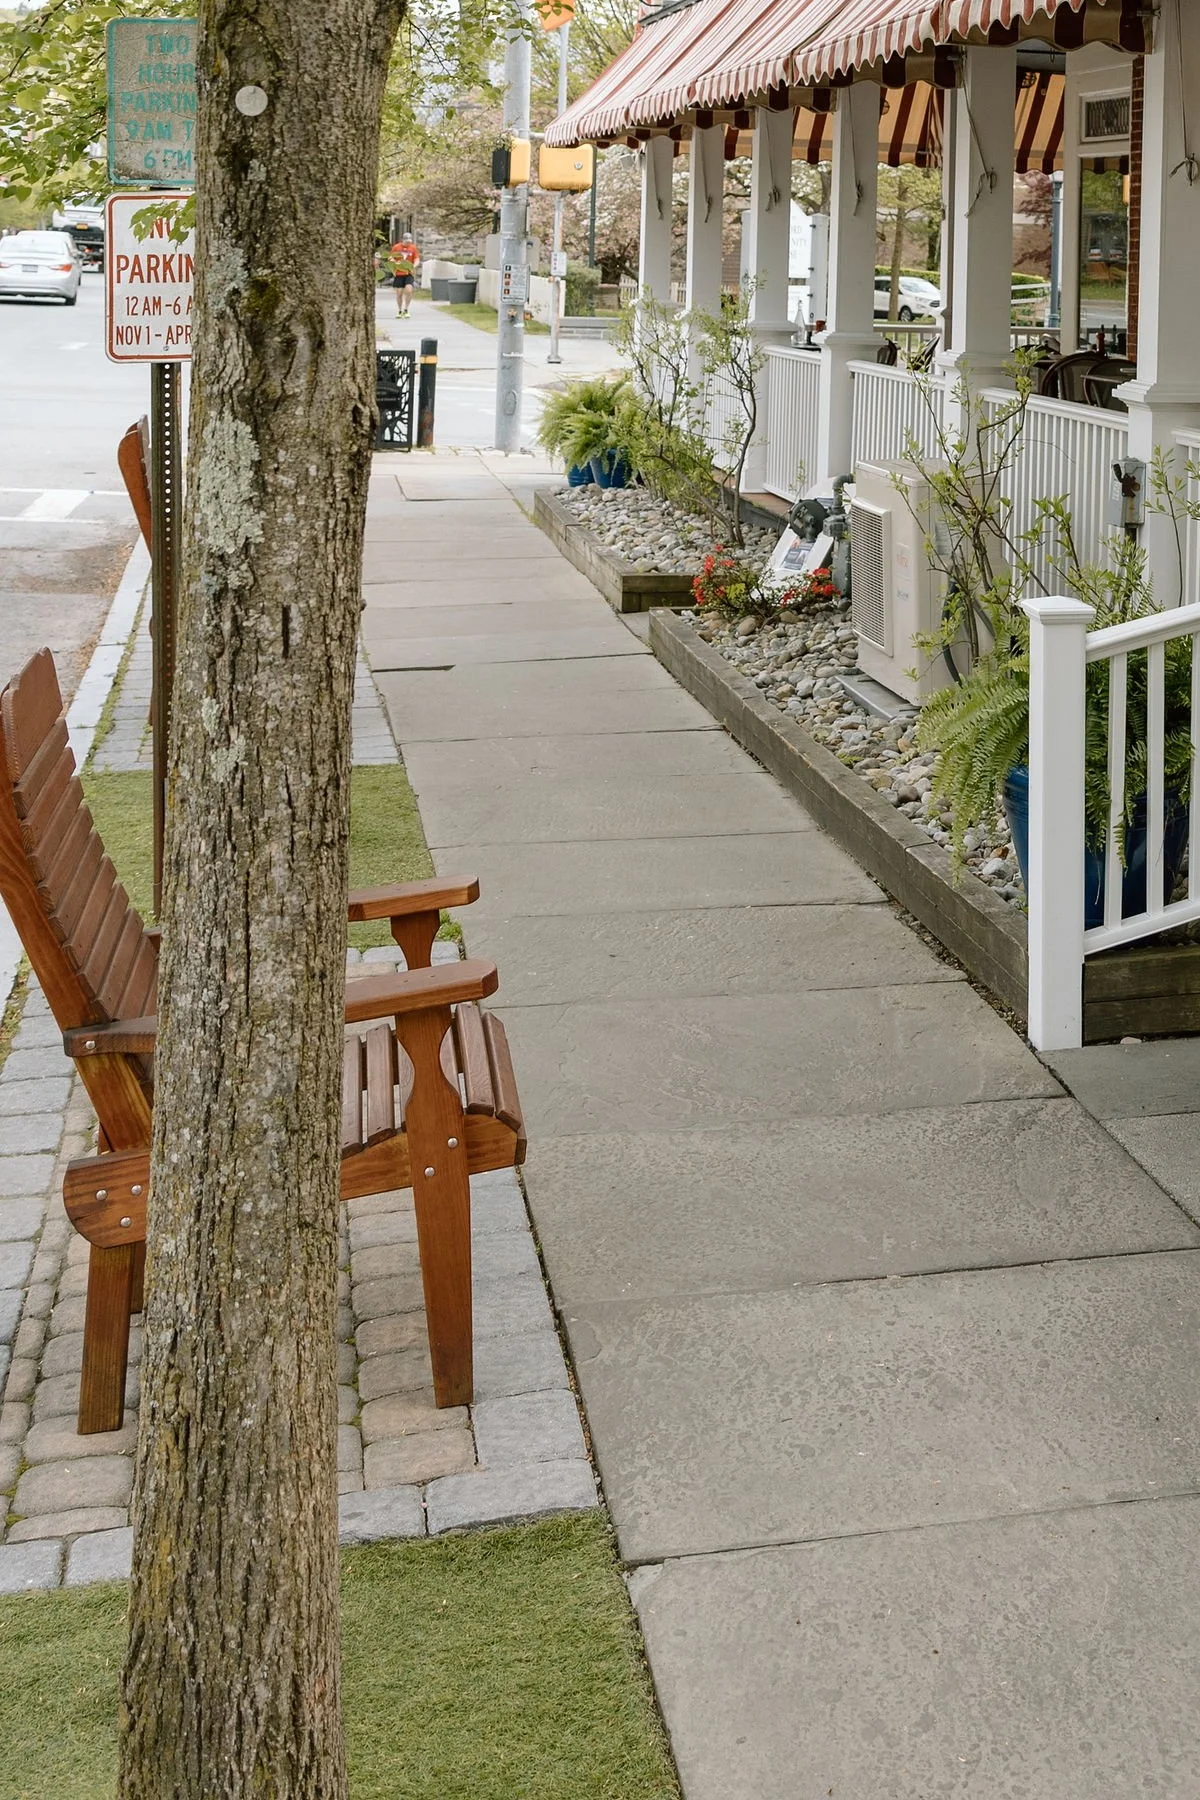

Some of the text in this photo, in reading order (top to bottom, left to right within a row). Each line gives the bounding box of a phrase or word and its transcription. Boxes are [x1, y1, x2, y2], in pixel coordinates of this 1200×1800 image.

[145, 33, 190, 56] TWO
[138, 63, 196, 85] HOUR
[121, 91, 197, 114] PARKIN
[183, 119, 195, 141] T
[143, 148, 192, 169] 6 PM
[116, 253, 195, 284] PARKIN
[116, 326, 142, 345] NOV
